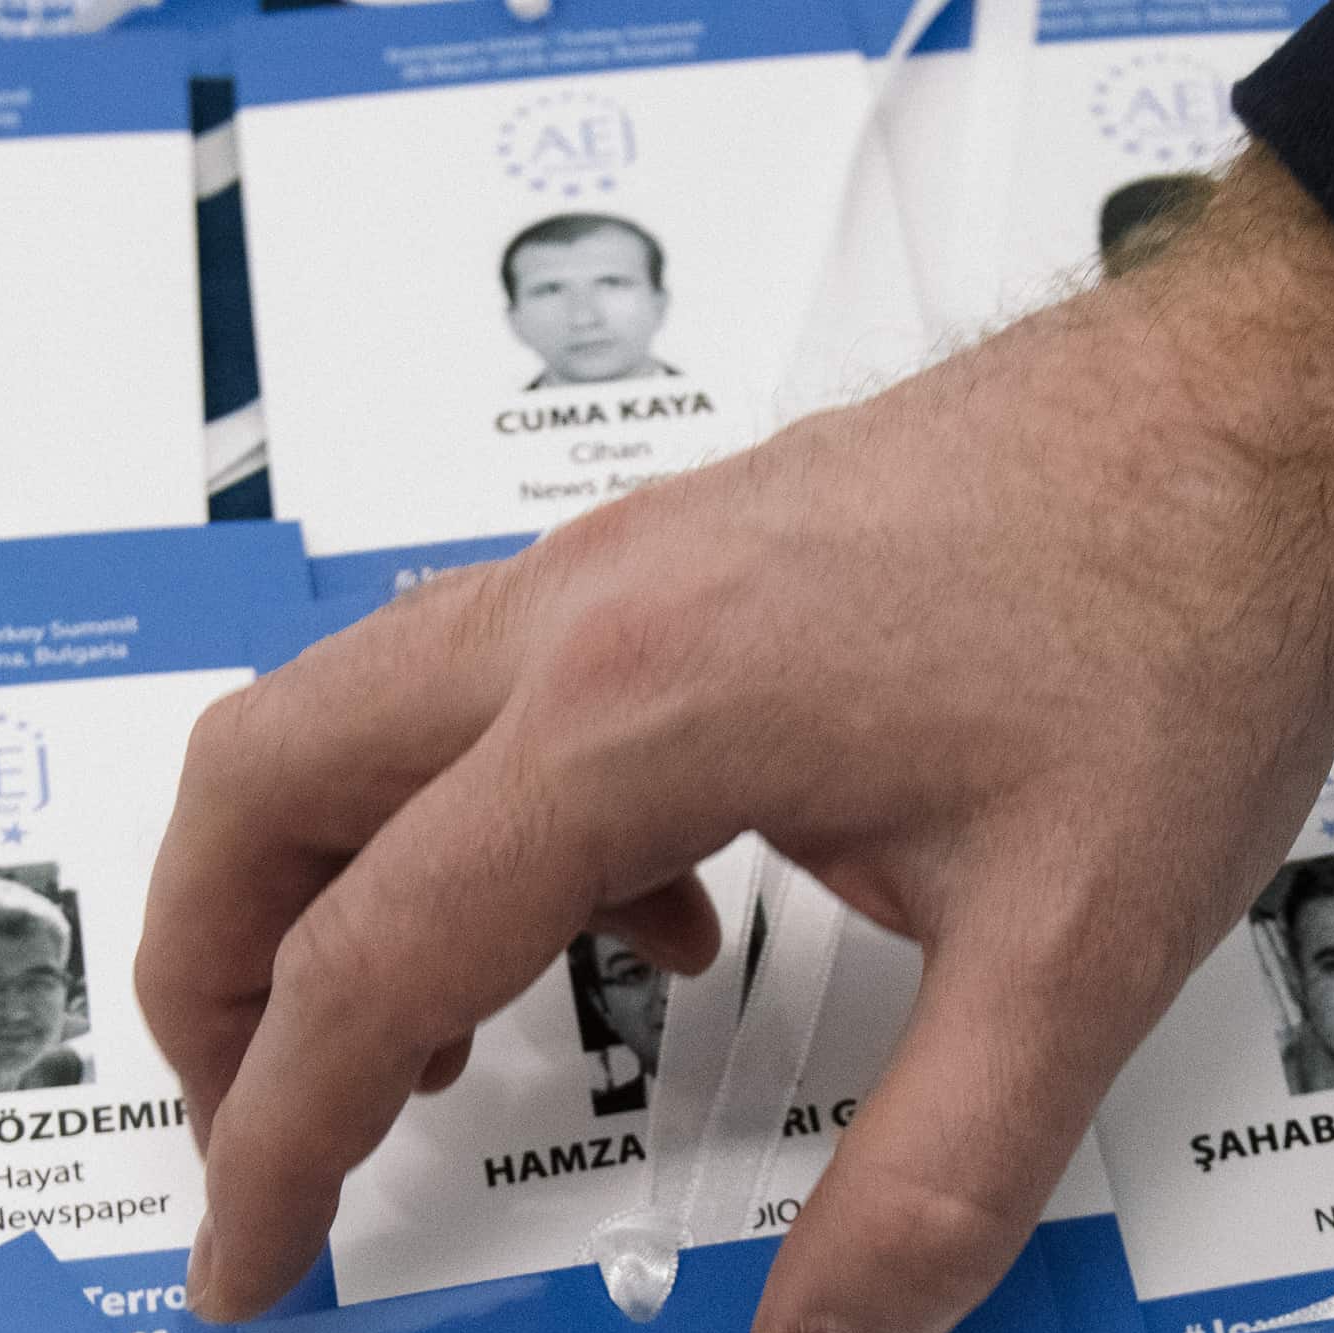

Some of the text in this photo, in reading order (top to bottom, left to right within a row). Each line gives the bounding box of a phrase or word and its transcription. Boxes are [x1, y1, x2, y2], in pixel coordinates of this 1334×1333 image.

[495, 392, 714, 434] CUMA KAYA
[47, 614, 138, 641] Summit
[32, 641, 127, 667] Bulgaria
[484, 1132, 646, 1188] HAMZA
